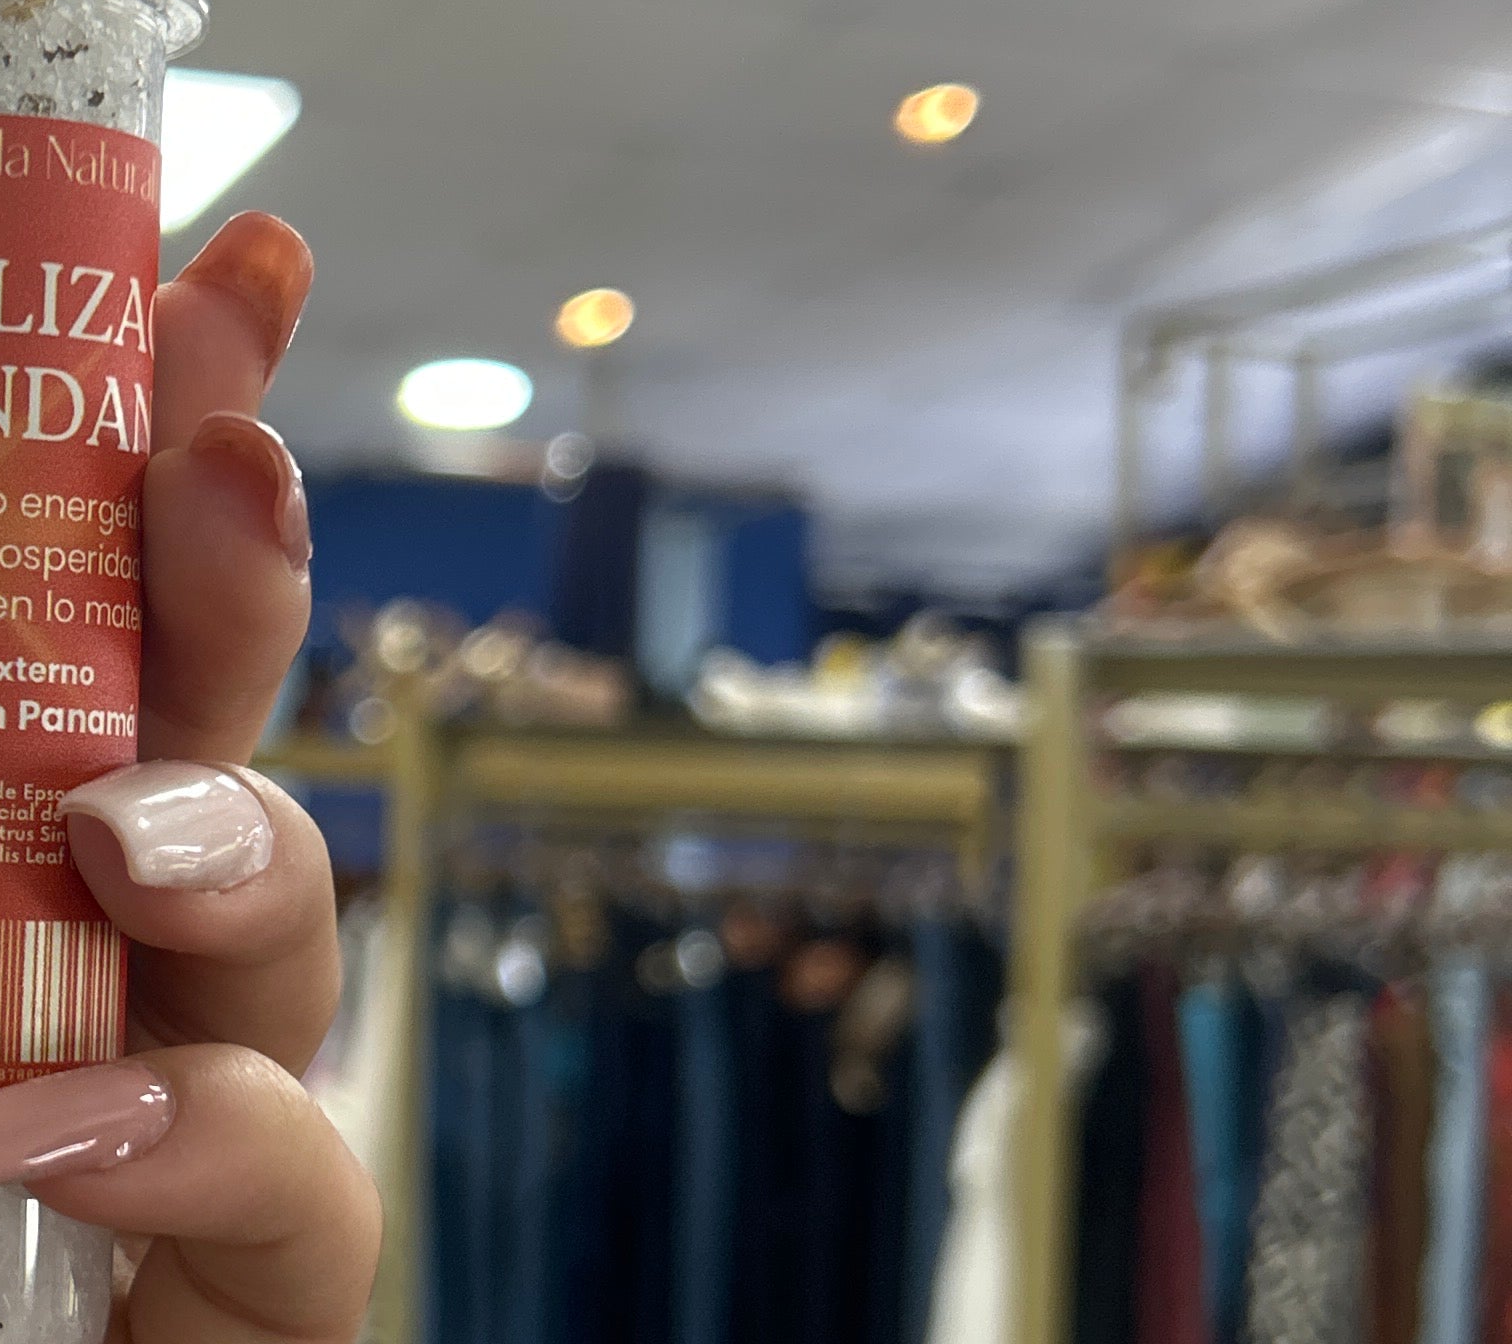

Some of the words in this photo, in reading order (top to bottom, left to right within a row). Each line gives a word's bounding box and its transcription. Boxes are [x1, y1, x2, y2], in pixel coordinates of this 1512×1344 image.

[45, 589, 75, 623] lo
[84, 600, 143, 634] mate
[17, 699, 136, 738] Panamá
[25, 845, 66, 866] Leaf
